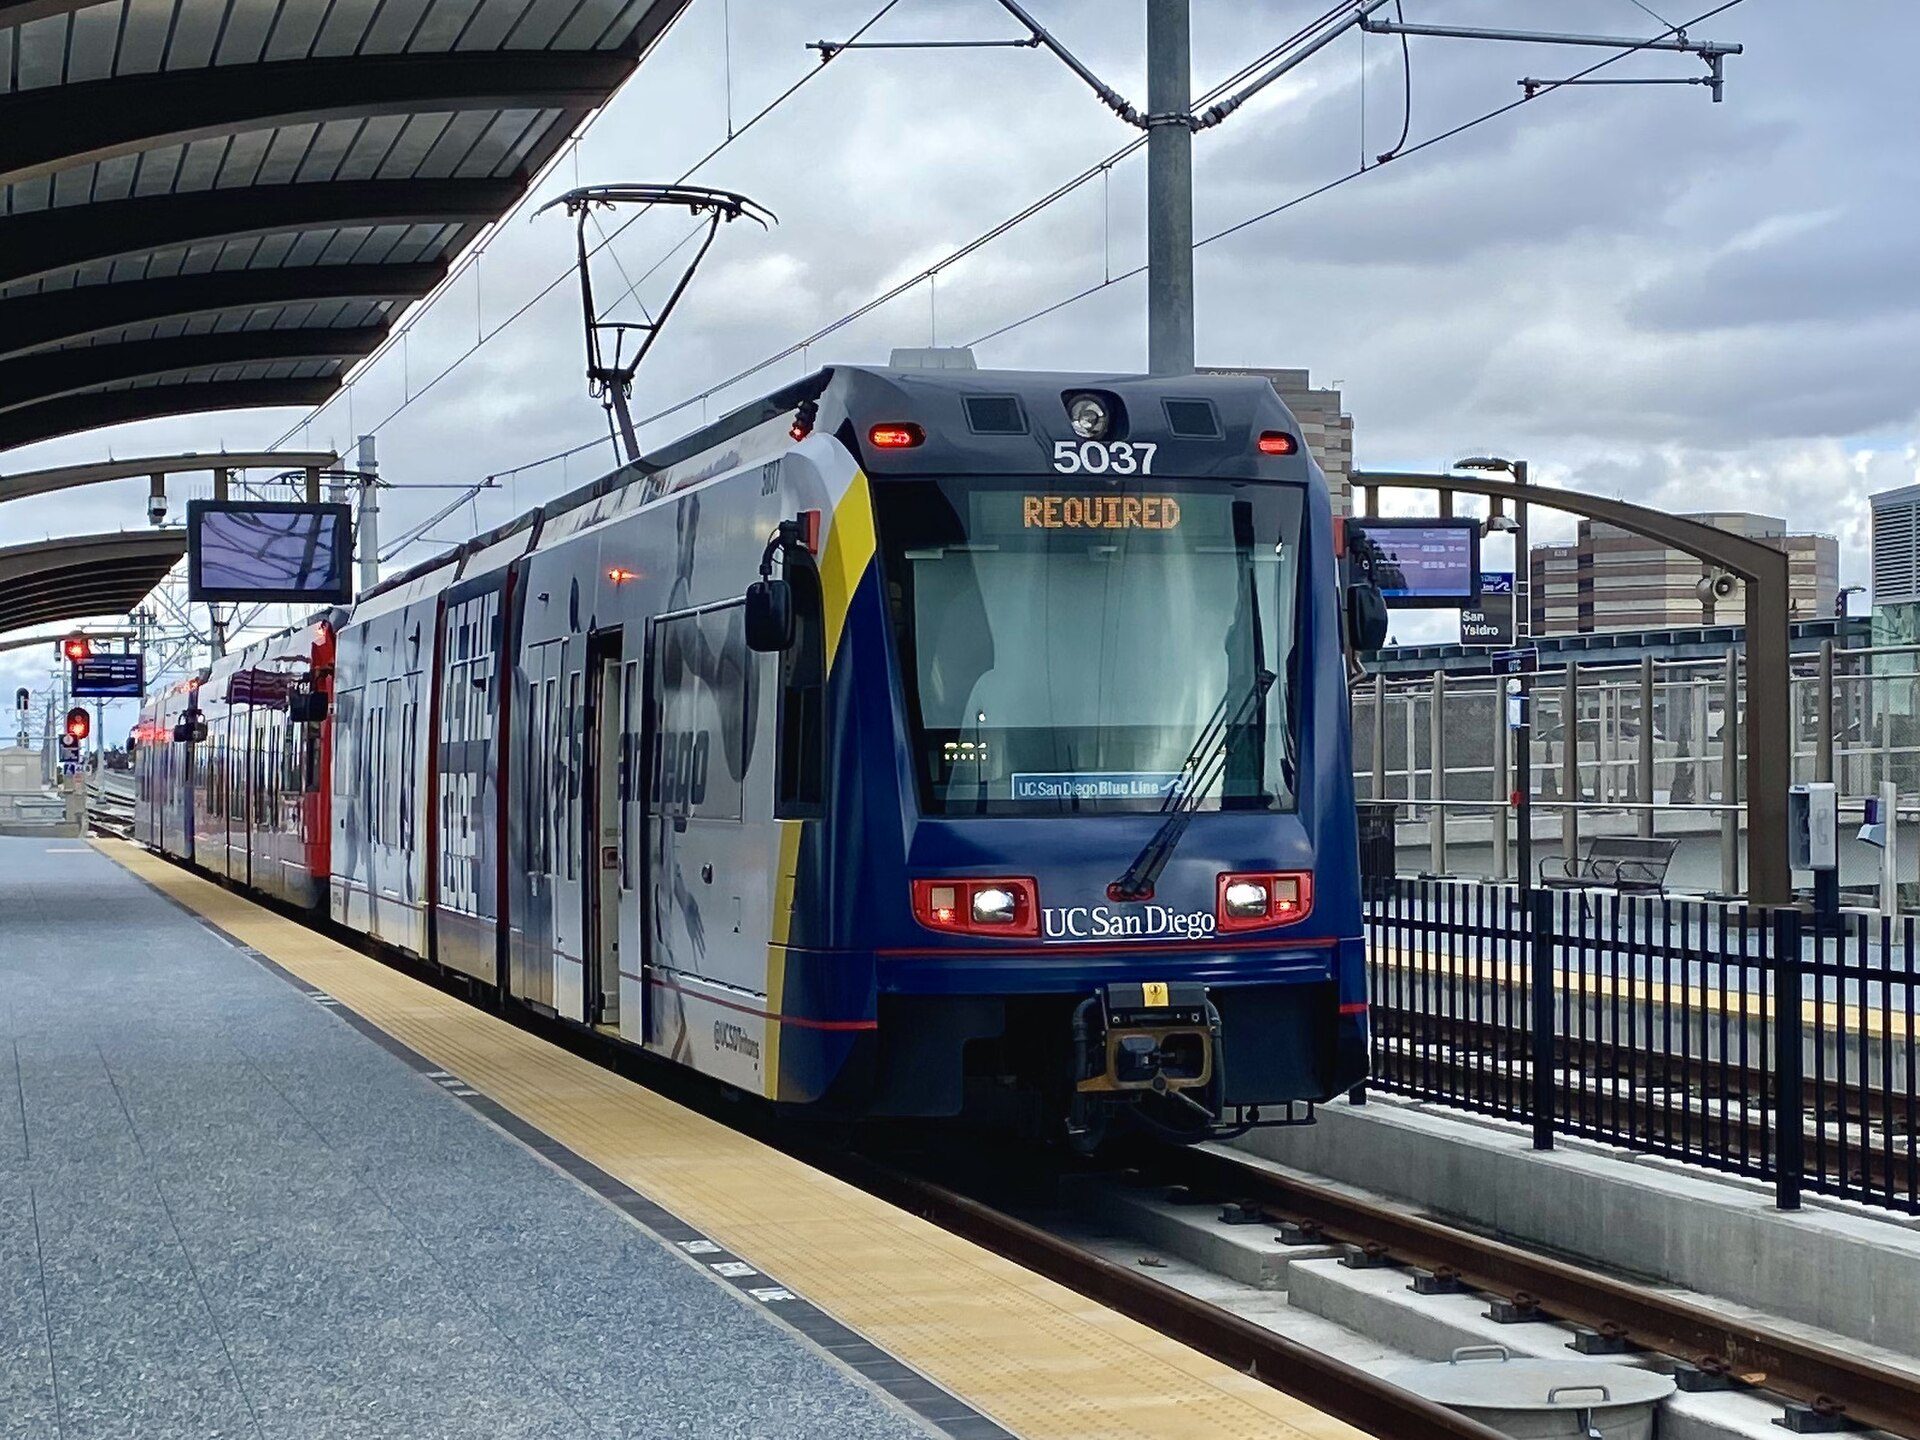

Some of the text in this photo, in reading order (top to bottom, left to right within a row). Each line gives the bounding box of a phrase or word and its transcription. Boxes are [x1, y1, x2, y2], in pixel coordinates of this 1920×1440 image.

[1053, 440, 1158, 475] 5037
[1022, 496, 1181, 529] REQUIRED
[1462, 610, 1485, 622] San
[1462, 624, 1499, 637] Ysidro
[1019, 781, 1159, 799] UC San Diego Blue Line
[1042, 905, 1216, 940] UC San Diego
